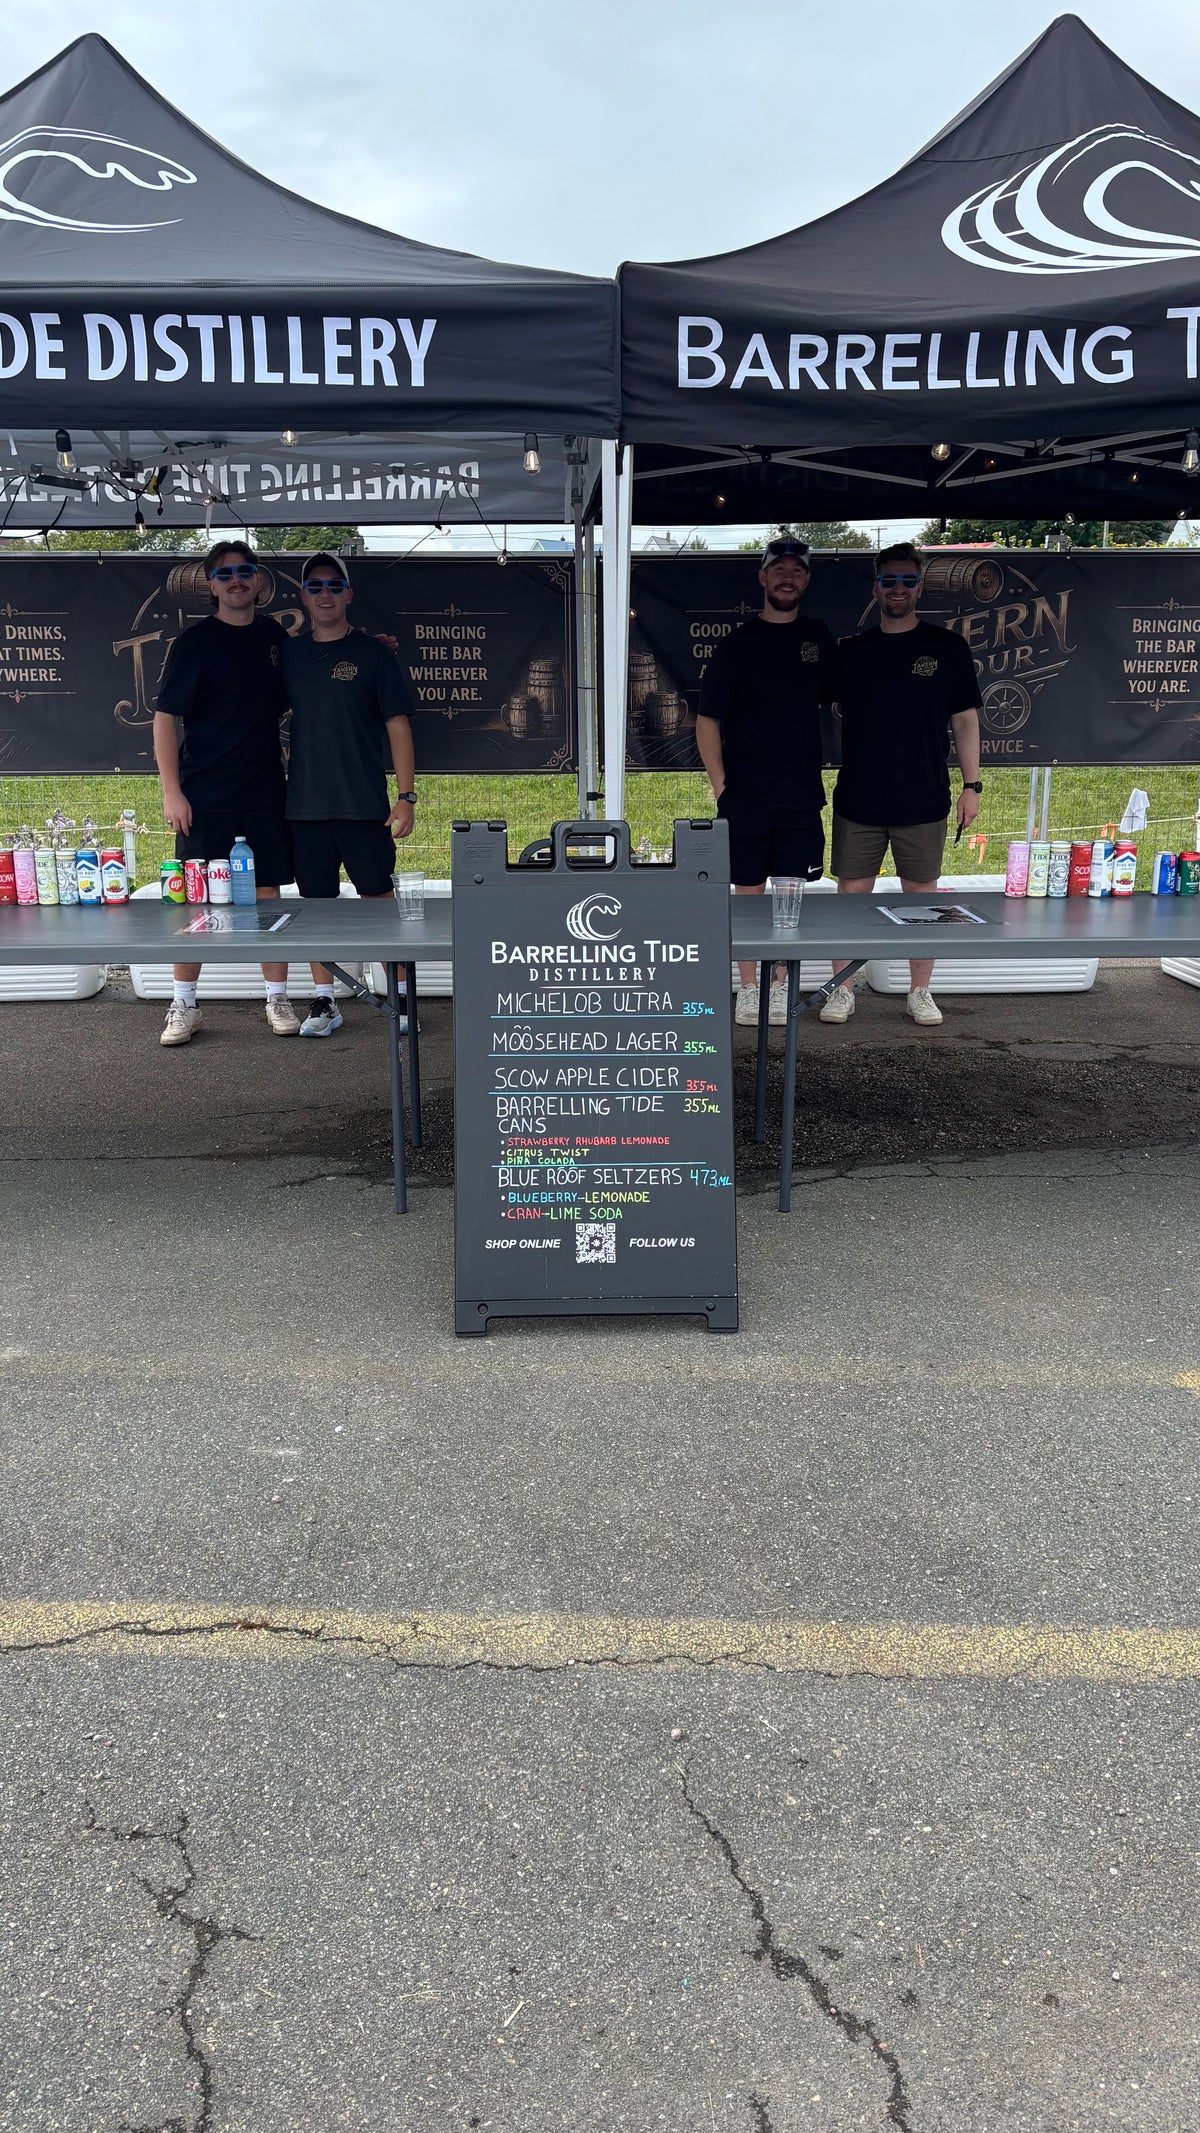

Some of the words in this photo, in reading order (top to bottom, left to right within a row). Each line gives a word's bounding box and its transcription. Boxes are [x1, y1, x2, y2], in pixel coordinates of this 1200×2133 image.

[84, 313, 437, 387] DISTILLERY
[677, 315, 1135, 391] BARRELLING
[5, 625, 67, 641] DRINKS,
[415, 624, 486, 640] BRINGING
[689, 622, 732, 638] GOOD
[1132, 618, 1200, 633] BRINGING
[16, 646, 65, 661] TIMES.
[420, 646, 448, 660] THE
[452, 646, 482, 660] BAR
[1136, 640, 1162, 653] THE
[1166, 639, 1196, 653] BAR
[409, 666, 488, 681] WHEREVER
[1123, 659, 1199, 674] WHEREVER
[1128, 679, 1157, 693] YOU
[1159, 680, 1190, 693] ARE.
[417, 687, 446, 701] YOU
[450, 687, 483, 701] ARE.
[982, 740, 1024, 754] RVICE
[207, 867, 231, 881] oke
[491, 941, 636, 964] BARRELLING
[643, 940, 700, 963] TIDE
[529, 967, 657, 982] DISTILLERY
[497, 992, 602, 1014] MICHELOB
[613, 991, 673, 1013] ULTRA
[615, 1031, 678, 1052] LAGER
[494, 1067, 549, 1089] SCOW
[555, 1067, 611, 1087] APPLE
[616, 1067, 680, 1088] CIDER
[496, 1096, 611, 1118] BARRELLING
[615, 1095, 665, 1113] TIDE
[498, 1117, 547, 1134] CANS
[508, 1137, 570, 1147] STRAWBERRY
[575, 1136, 617, 1146] RHUBARB
[621, 1136, 671, 1145] LEMONADE
[506, 1148, 543, 1158] CITRUS
[550, 1148, 590, 1157] TWIST
[538, 1157, 575, 1165] COLADA
[498, 1168, 540, 1187] BLUE
[593, 1168, 683, 1185] SELTZERS
[589, 1207, 623, 1220] SODA
[485, 1239, 517, 1249] SHOP
[519, 1239, 561, 1249] ONLINE
[629, 1238, 679, 1248] FOLLOW
[680, 1238, 695, 1248] US
